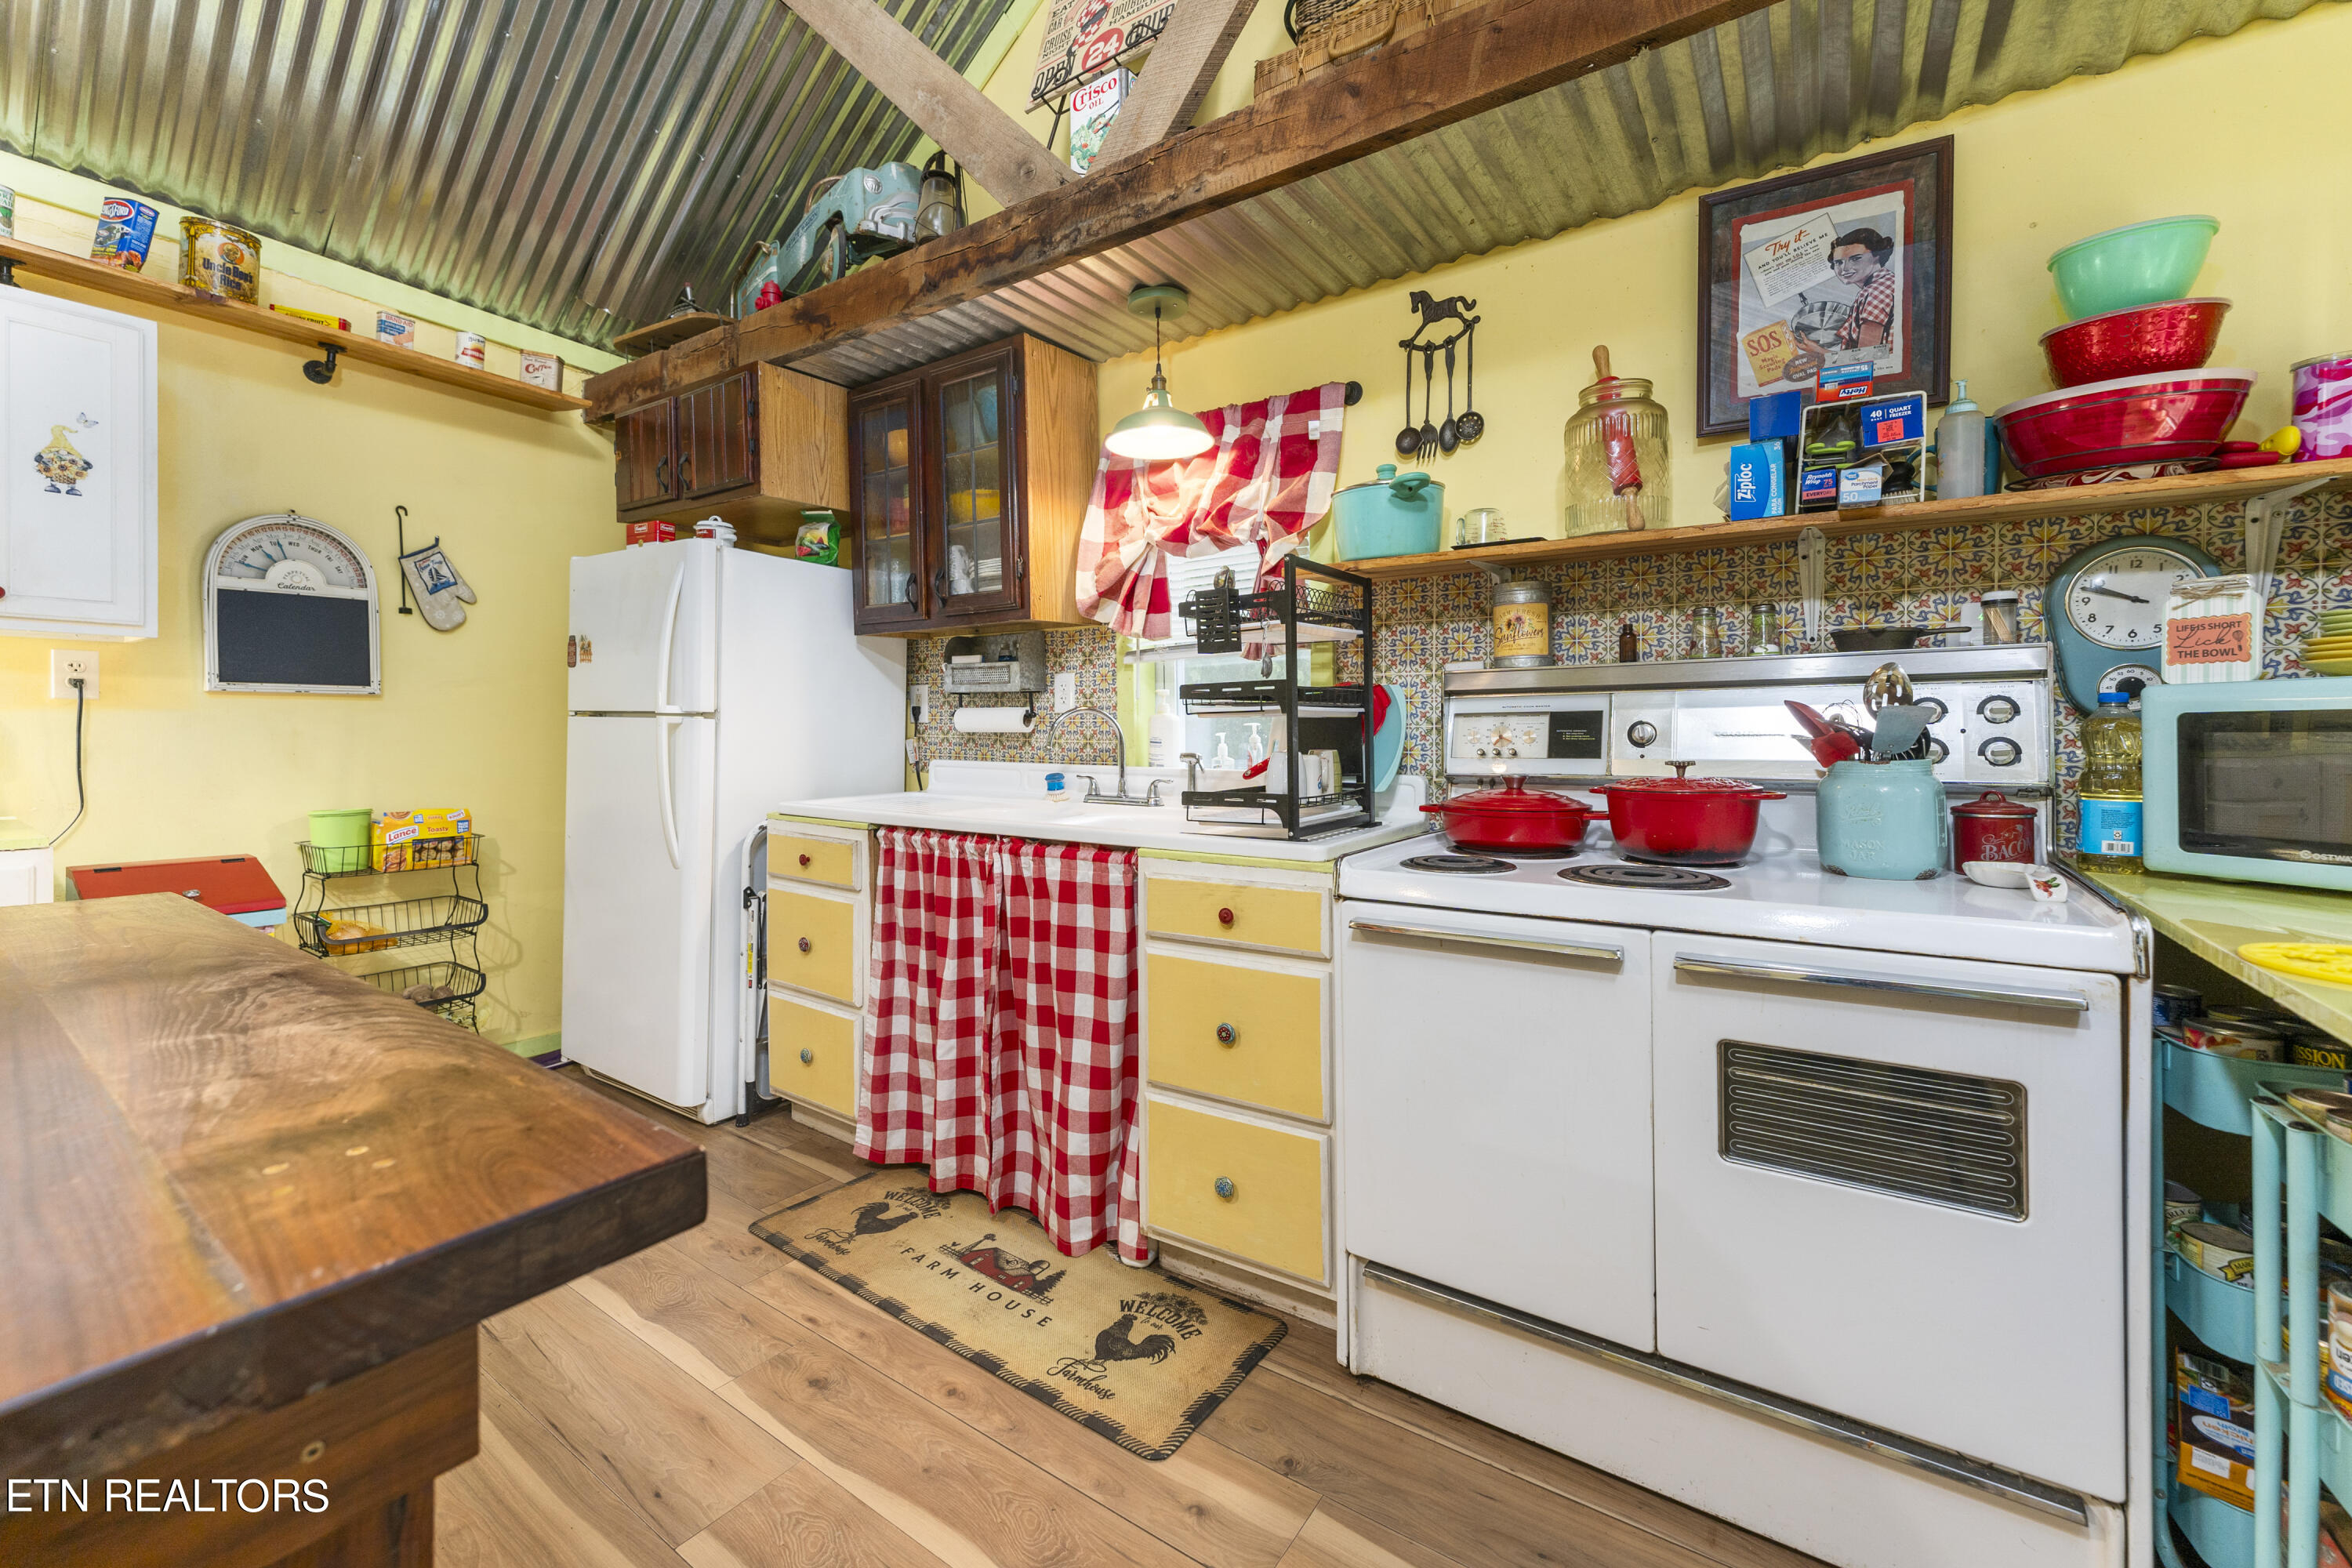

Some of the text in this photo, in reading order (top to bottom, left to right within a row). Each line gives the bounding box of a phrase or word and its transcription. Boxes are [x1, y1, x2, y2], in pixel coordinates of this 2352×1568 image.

[1044, 27, 1073, 53] CRUISE
[1086, 33, 1120, 70] 24
[1073, 78, 1117, 112] Crisco
[1088, 99, 1104, 110] OIL
[1765, 240, 1791, 256] Try
[1758, 261, 1769, 270] AND
[1793, 238, 1817, 252] BELIEVE
[202, 257, 231, 276] Uncle
[220, 274, 241, 291] Rice
[1792, 371, 1806, 379] OVAL
[1840, 387, 1866, 395] Hefty
[1870, 409, 1882, 418] 40
[1889, 405, 1912, 413] QUART
[1773, 441, 1781, 451] 36
[1737, 463, 1756, 500] Ziploc
[1842, 492, 1858, 503] 50
[307, 545, 322, 554] THUR
[2130, 559, 2143, 568] 12
[2159, 562, 2164, 571] 1
[2108, 565, 2118, 574] 11
[277, 583, 316, 591] Calendar
[2082, 597, 2091, 606] 9
[2088, 613, 2097, 622] 8
[2105, 625, 2114, 634] 7
[2153, 624, 2162, 633] 5
[2208, 621, 2242, 630] SHORT
[1494, 626, 1544, 648] Sunflowers
[2128, 629, 2138, 638] 6
[2173, 625, 2231, 648] Lick
[2176, 648, 2238, 659] THE BOWL
[388, 827, 417, 842] Lance
[1980, 837, 2033, 861] BACON
[1849, 851, 1876, 860] JAR
[884, 1190, 942, 1220] WELCOME
[804, 1228, 851, 1255] Farmhouse
[900, 1247, 1053, 1327] FARM HOUSE
[1120, 1299, 1203, 1341] WELCOME
[1047, 1357, 1116, 1399] Farmhouse
